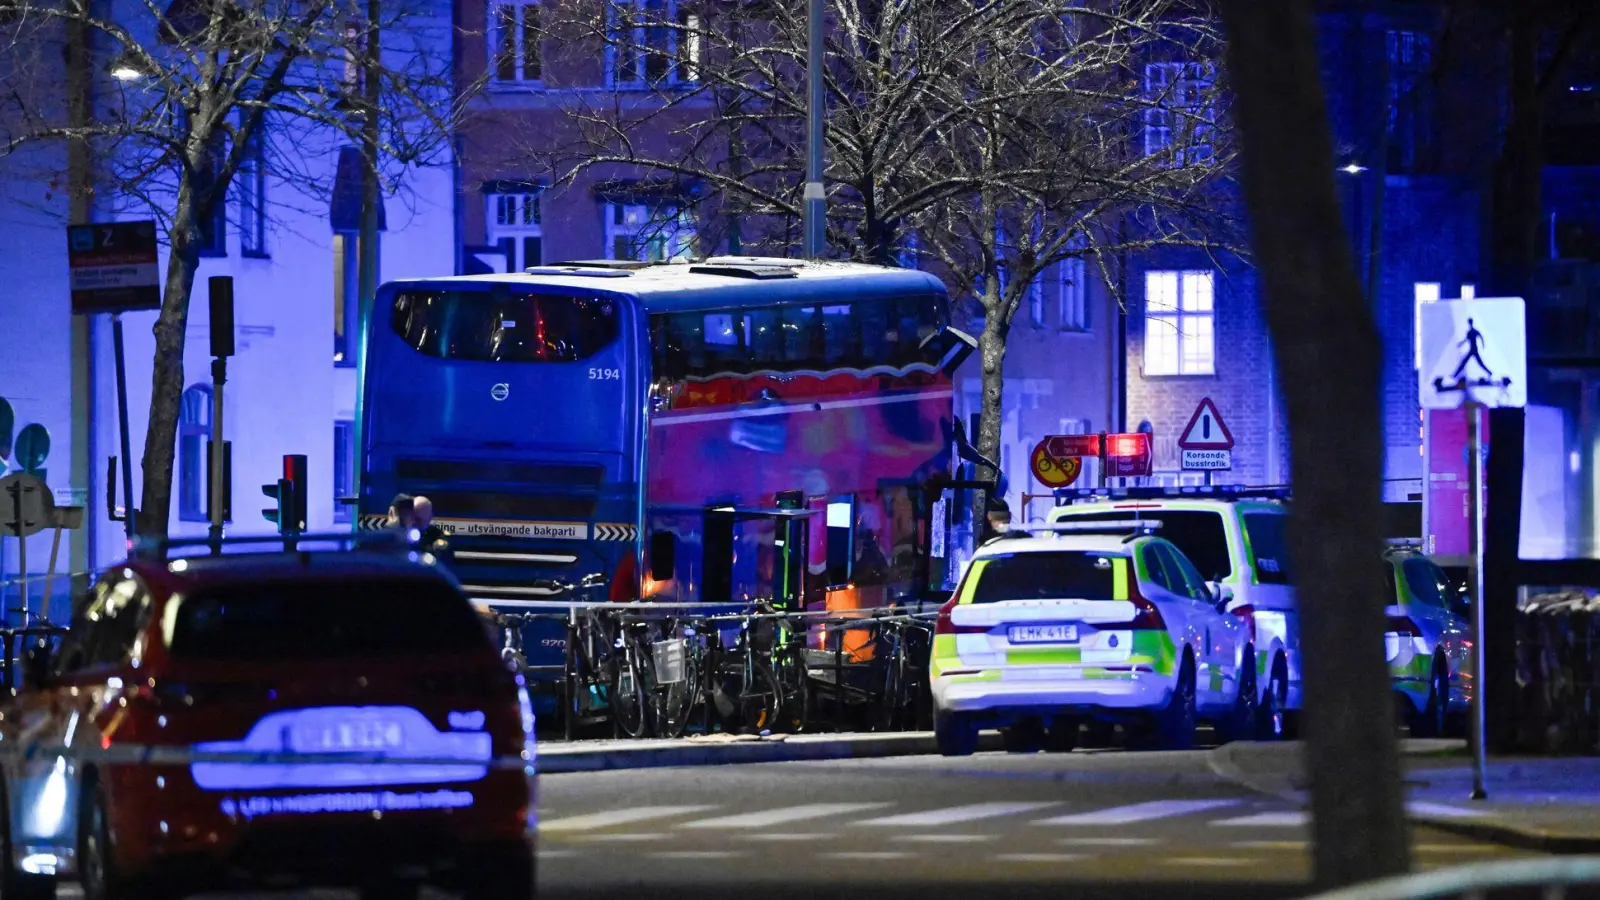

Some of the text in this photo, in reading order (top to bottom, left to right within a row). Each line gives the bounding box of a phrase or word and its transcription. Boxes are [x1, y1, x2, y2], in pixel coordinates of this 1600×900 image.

[589, 368, 619, 380] 5194
[434, 522, 455, 534] ning
[468, 524, 531, 536] utsvängande
[534, 525, 576, 537] bakparti
